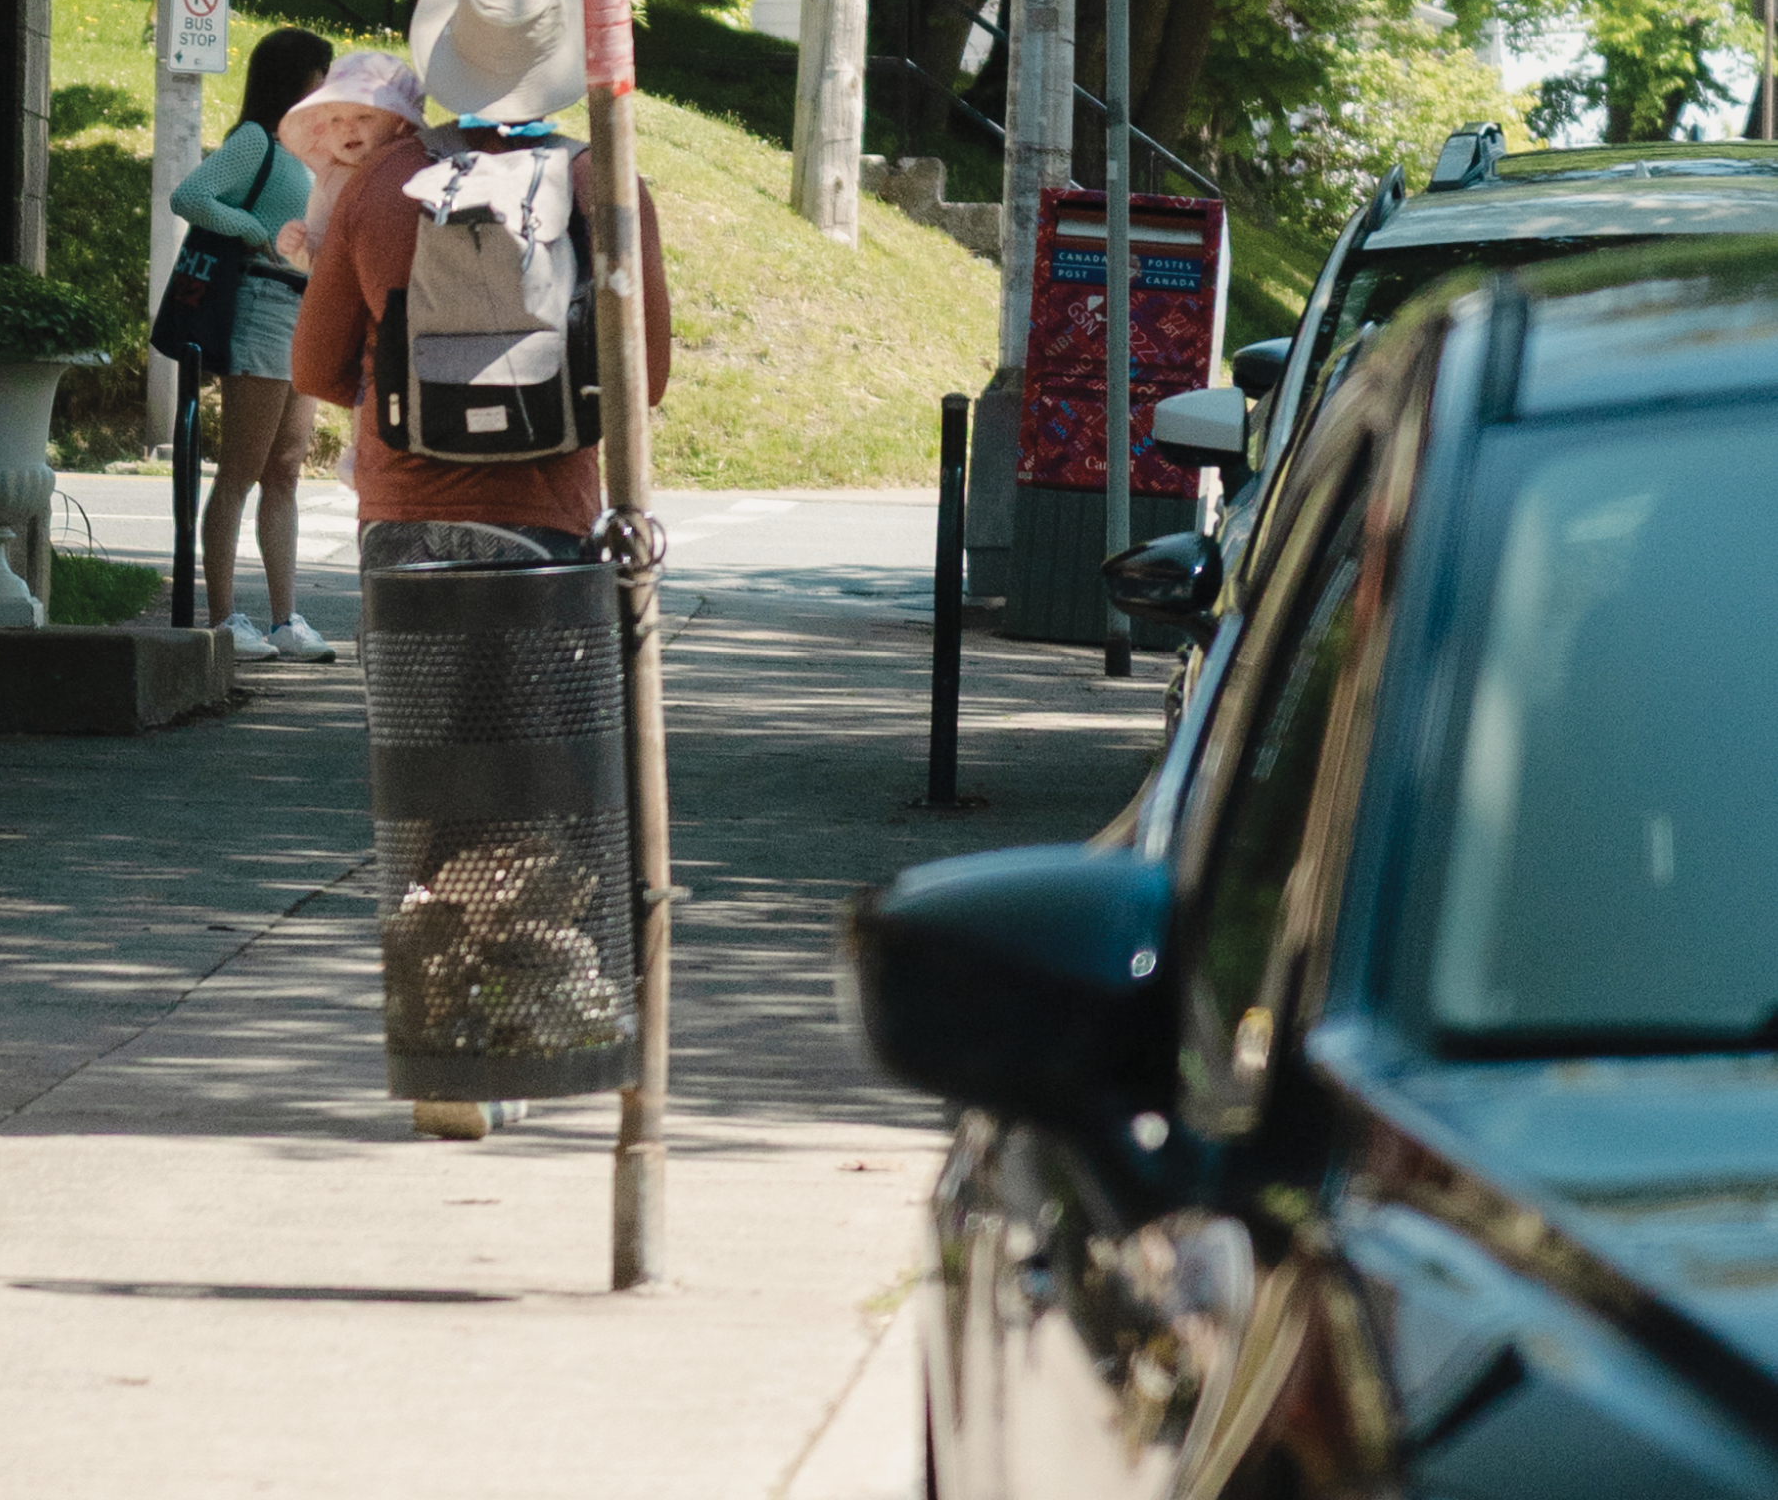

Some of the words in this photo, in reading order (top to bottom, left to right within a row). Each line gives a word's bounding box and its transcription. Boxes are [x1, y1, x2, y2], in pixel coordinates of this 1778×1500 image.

[184, 17, 213, 31] BUS
[179, 32, 217, 47] STOP
[1058, 252, 1107, 264] CANADA
[1148, 259, 1192, 270] POSTES
[1058, 269, 1088, 279] POST
[1146, 277, 1196, 288] CANADA
